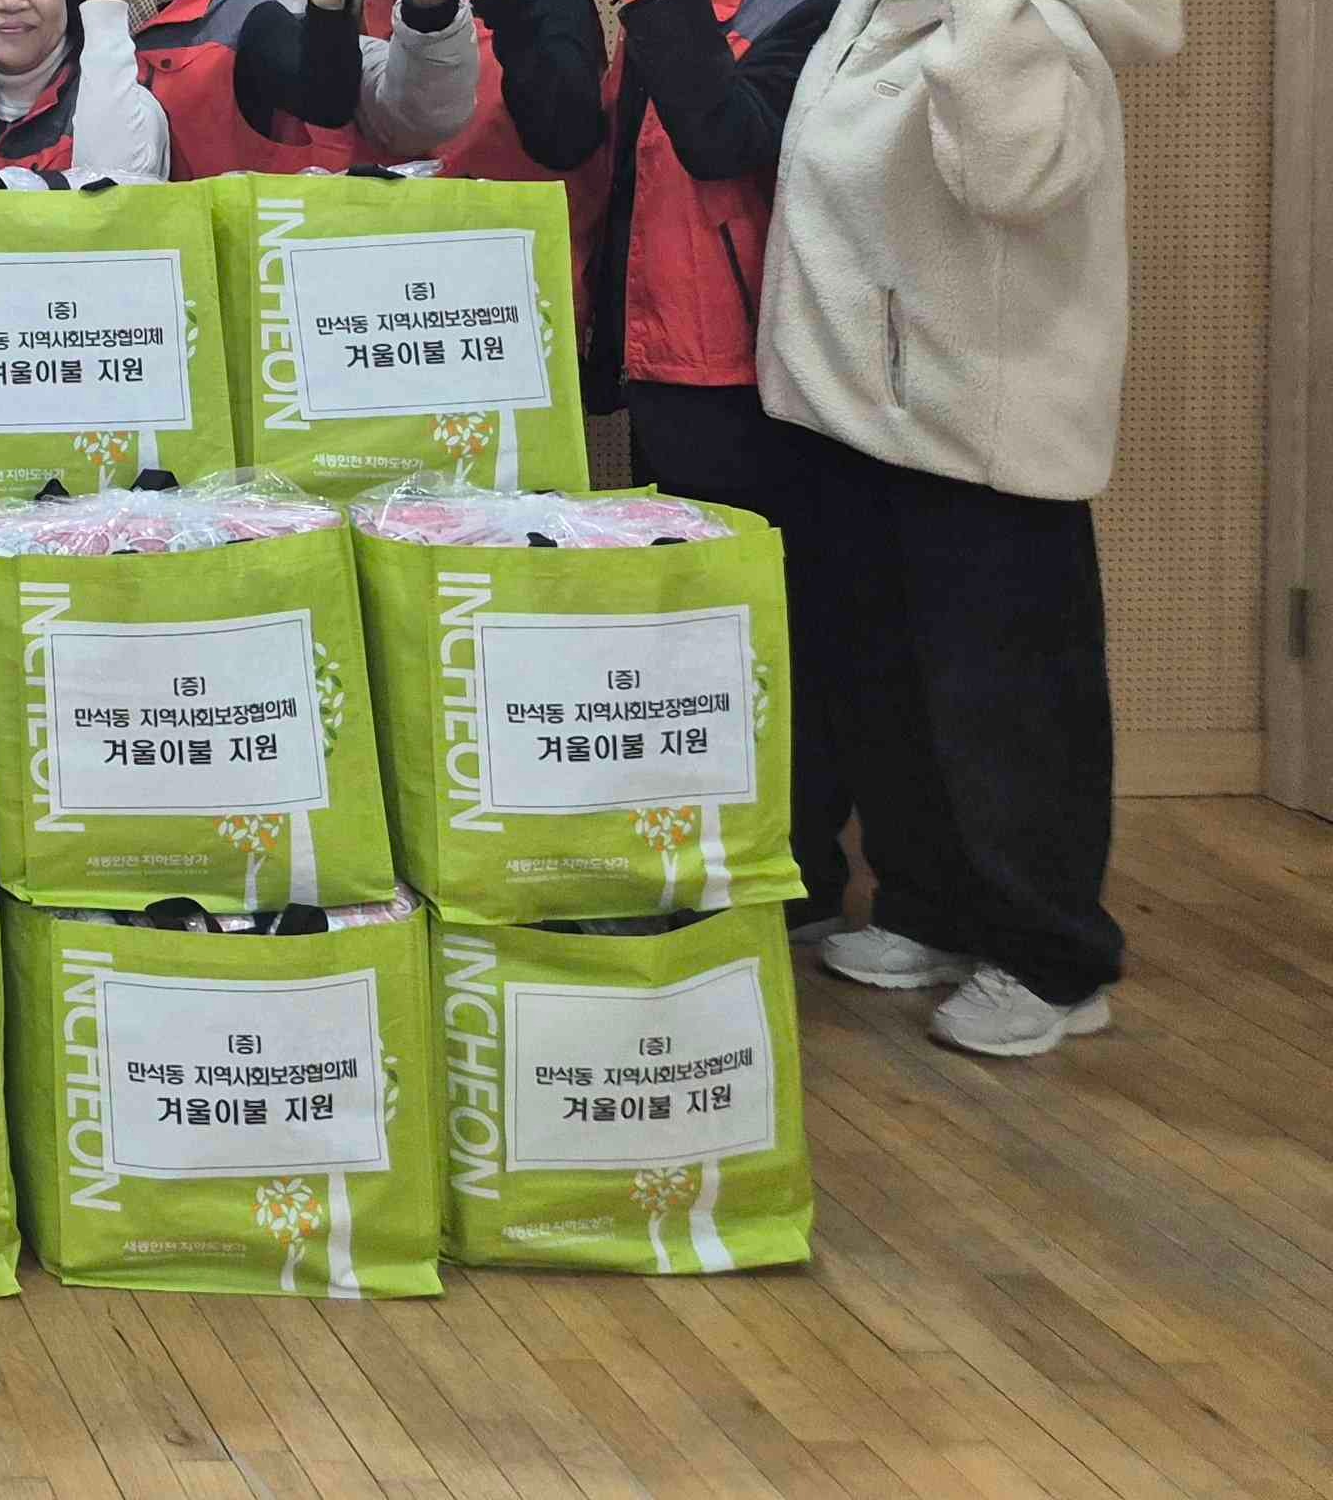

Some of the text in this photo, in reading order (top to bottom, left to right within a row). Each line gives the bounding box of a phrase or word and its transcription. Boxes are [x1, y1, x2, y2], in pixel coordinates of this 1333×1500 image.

[316, 306, 519, 335] 만석동 지역사회보장협의체
[18, 328, 163, 349] 지역사회보장협의체
[345, 336, 504, 369] 겨울이불 지원
[98, 358, 143, 382] 지원
[75, 698, 297, 728] 만석동 지역사회보장협의체
[507, 693, 729, 724] 만석동 지역사회보장협의체
[104, 734, 278, 765] 겨울이불 지원
[538, 727, 708, 762] 겨울이불 지원
[128, 1058, 357, 1086] 만석동 지역사회보장협의체
[443, 934, 500, 1199] INCHEON
[535, 1047, 753, 1086] 만석동 지역사회보장협의체
[157, 1094, 334, 1125] 겨울이불 지원
[562, 1085, 732, 1122] 겨울이불 지원
